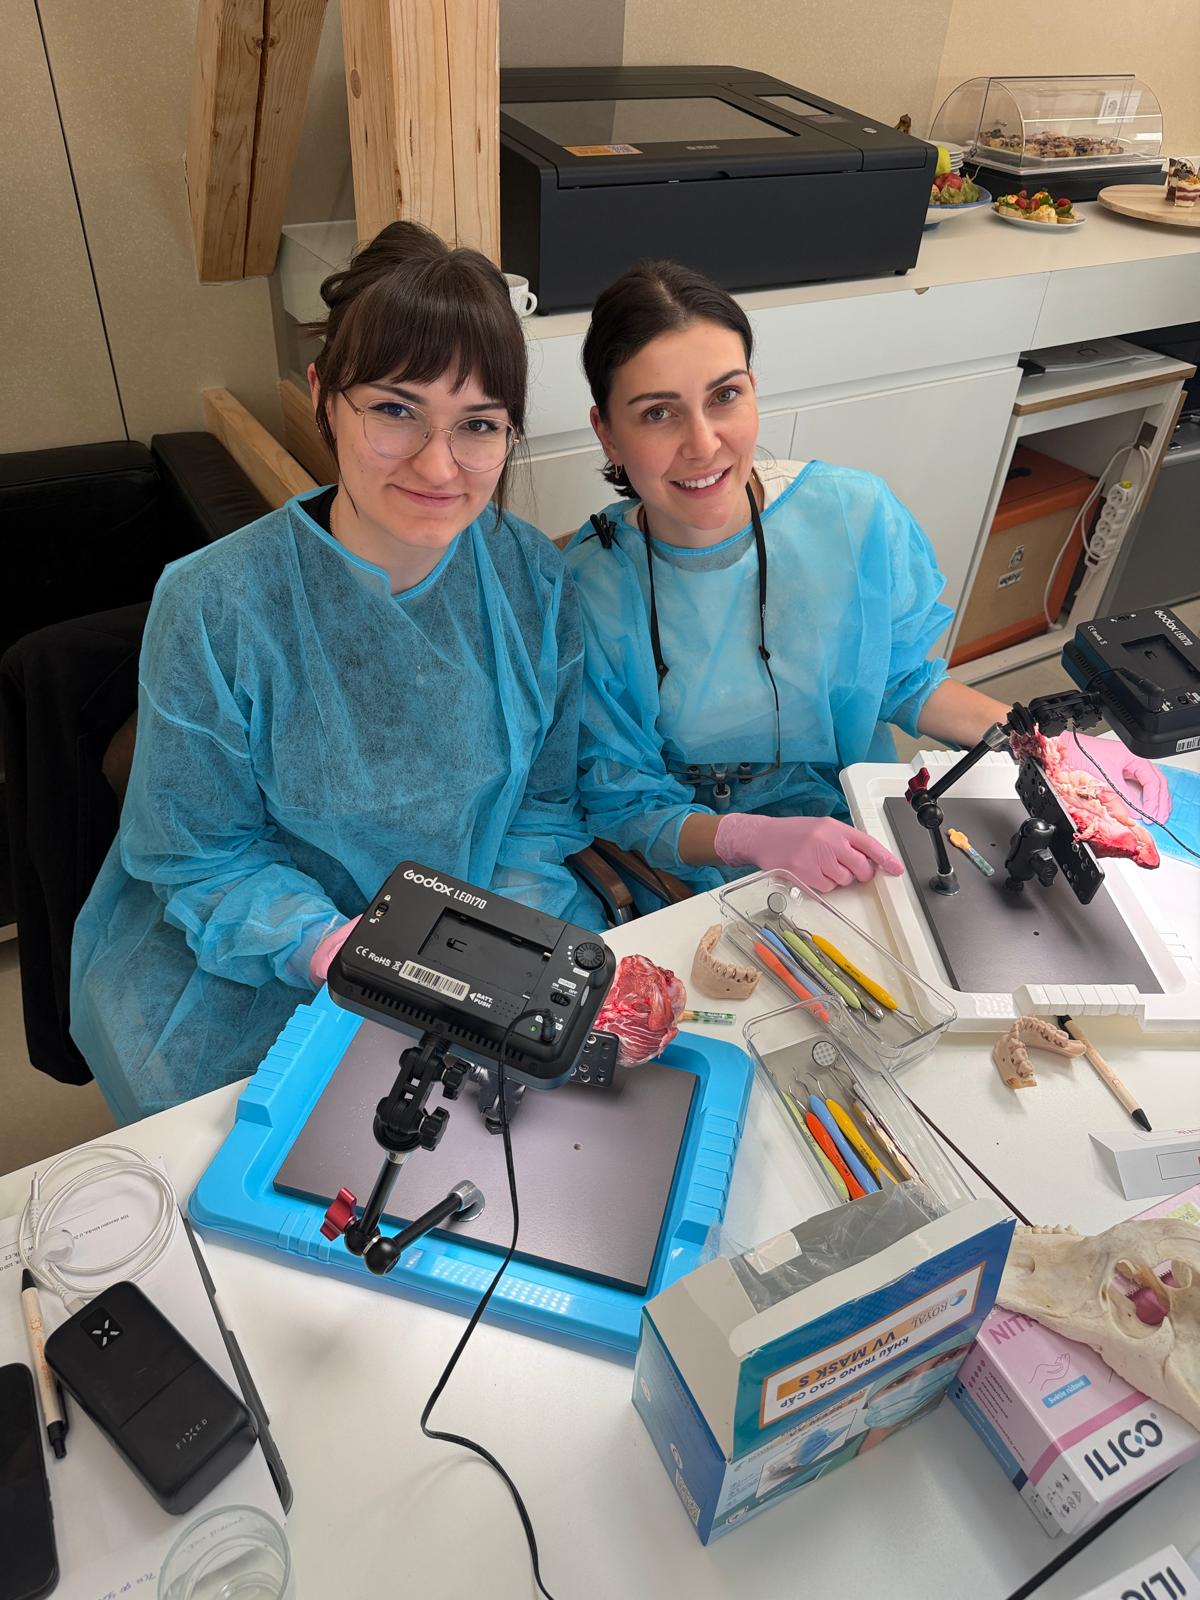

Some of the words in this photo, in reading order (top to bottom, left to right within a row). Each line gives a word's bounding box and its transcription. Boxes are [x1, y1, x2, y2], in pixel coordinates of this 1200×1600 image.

[1154, 609, 1178, 631] Godox
[403, 869, 455, 897] Godox
[453, 889, 488, 910] LED170
[355, 946, 369, 957] CE
[368, 952, 392, 967] RoHS
[473, 998, 492, 1009] PUSH
[911, 1300, 949, 1328] ROYAL
[872, 1331, 896, 1352] VV
[816, 1346, 867, 1377] MASK
[839, 1355, 878, 1379] TRANG
[798, 1375, 810, 1387] S
[809, 1376, 837, 1395] CAO
[176, 1418, 208, 1449] FIXED
[1084, 1418, 1163, 1482] ILICO
